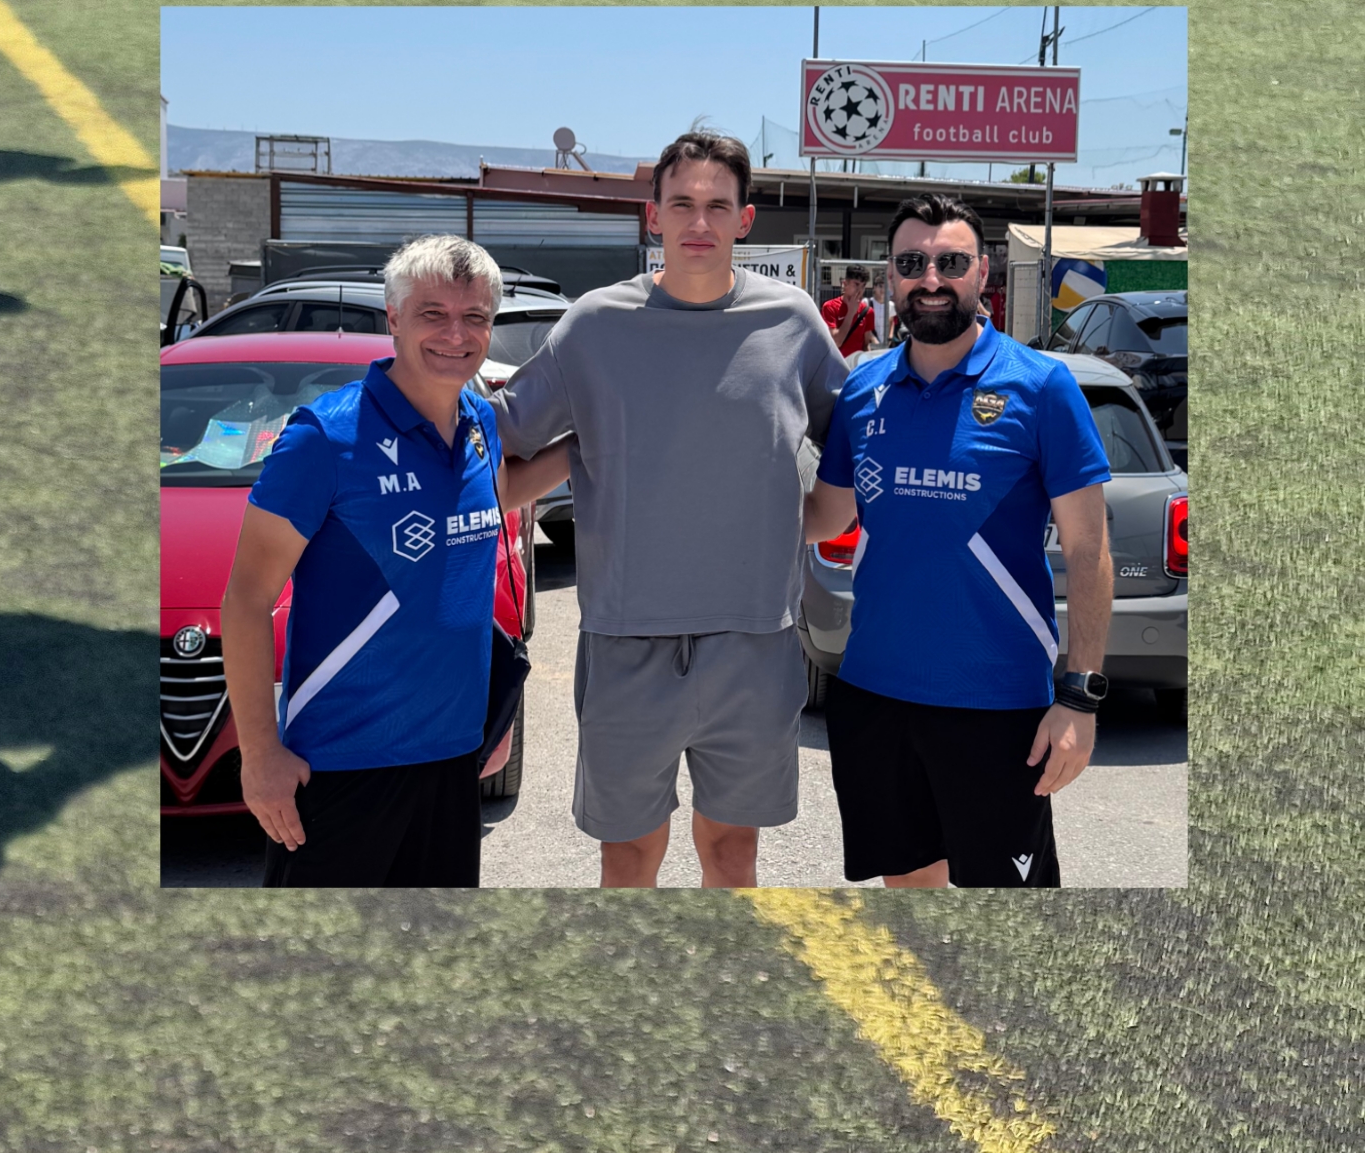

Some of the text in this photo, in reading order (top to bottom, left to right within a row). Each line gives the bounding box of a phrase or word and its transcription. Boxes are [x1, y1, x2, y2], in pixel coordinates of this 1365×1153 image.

[810, 65, 852, 107] RENTI
[898, 83, 1077, 115] RENTI ARENA
[912, 123, 1054, 145] football club
[376, 471, 423, 496] M.A
[894, 466, 982, 492] ELEMIS
[893, 487, 968, 501] CONSTRUCTIONS
[445, 506, 502, 536] ELEMIS
[445, 528, 499, 547] CONSTRUCTIONS
[1119, 566, 1149, 577] ONE
